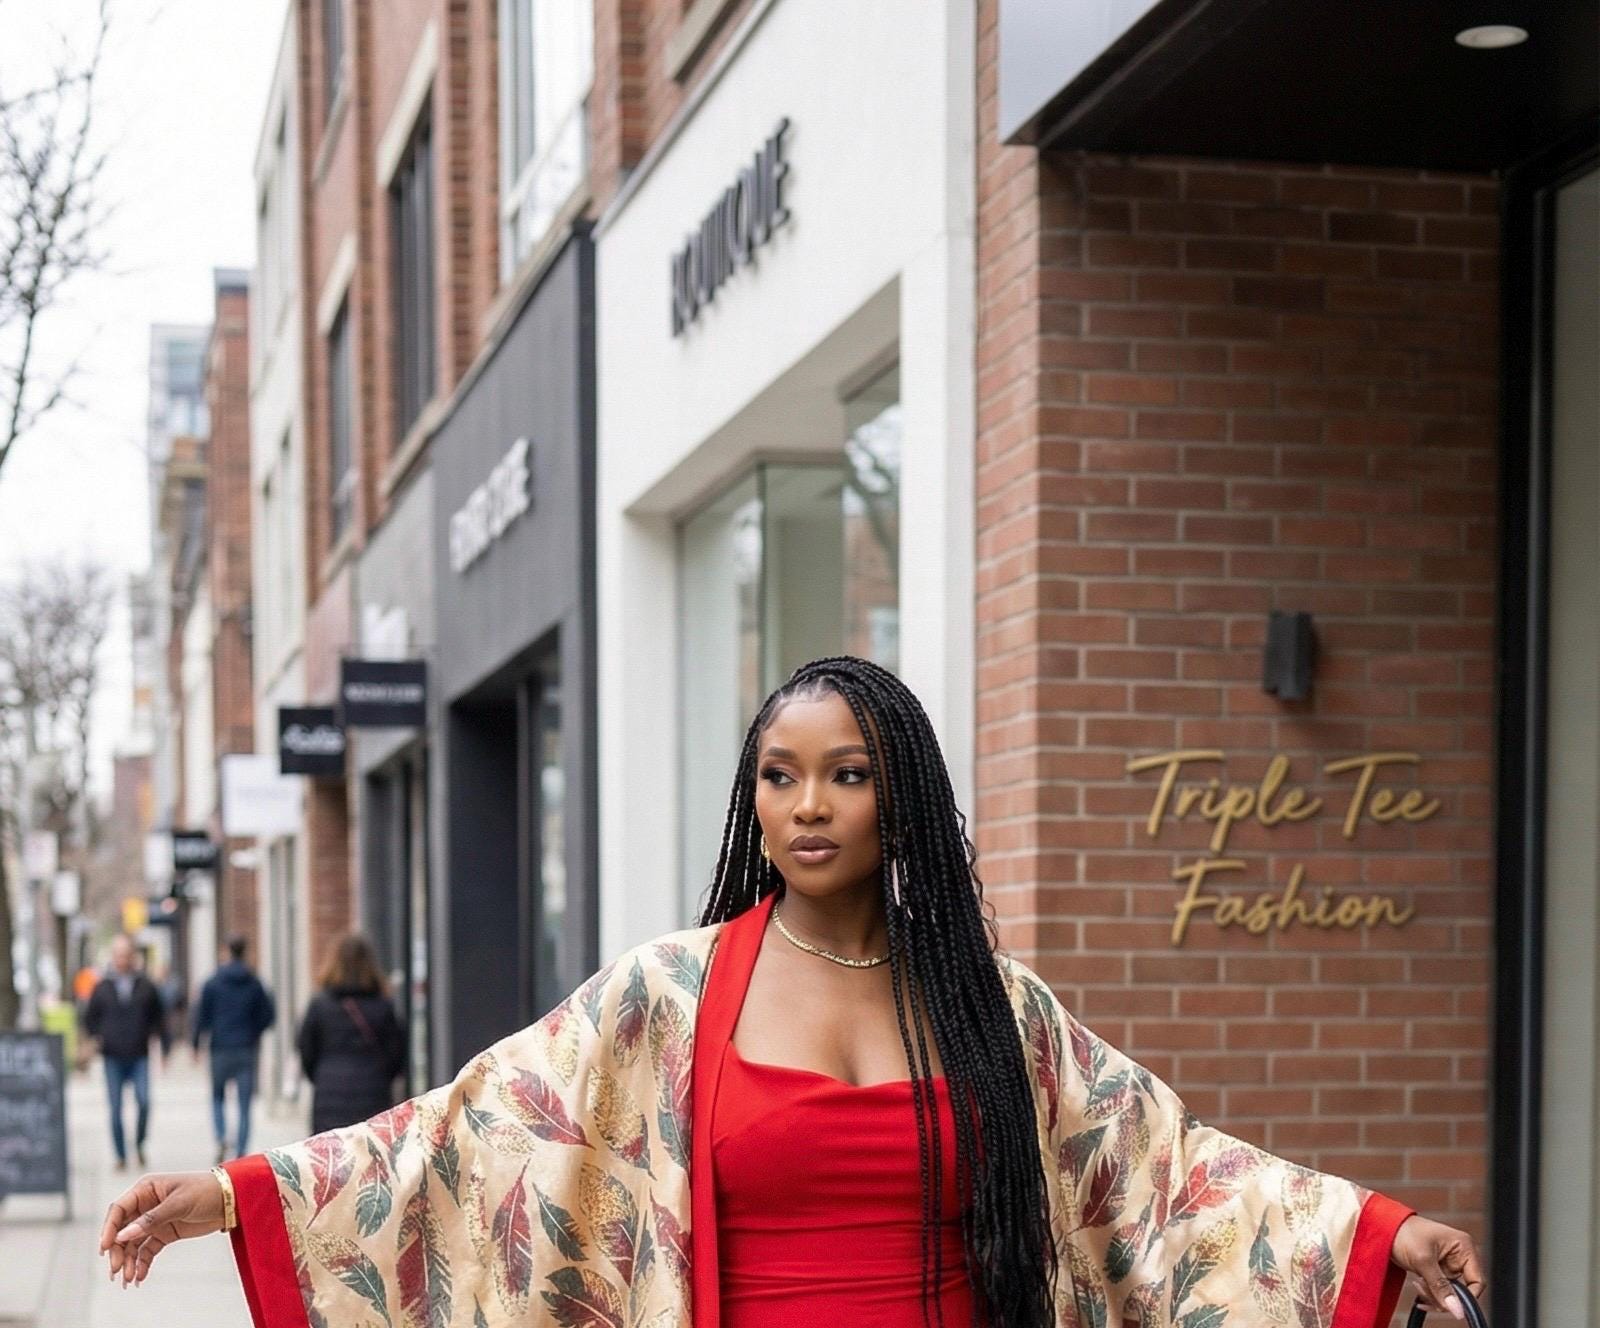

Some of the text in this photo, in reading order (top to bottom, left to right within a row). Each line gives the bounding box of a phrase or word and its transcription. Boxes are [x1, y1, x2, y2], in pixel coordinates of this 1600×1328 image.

[1125, 749, 1441, 854] Triple Tee
[1170, 857, 1416, 948] Fashion
